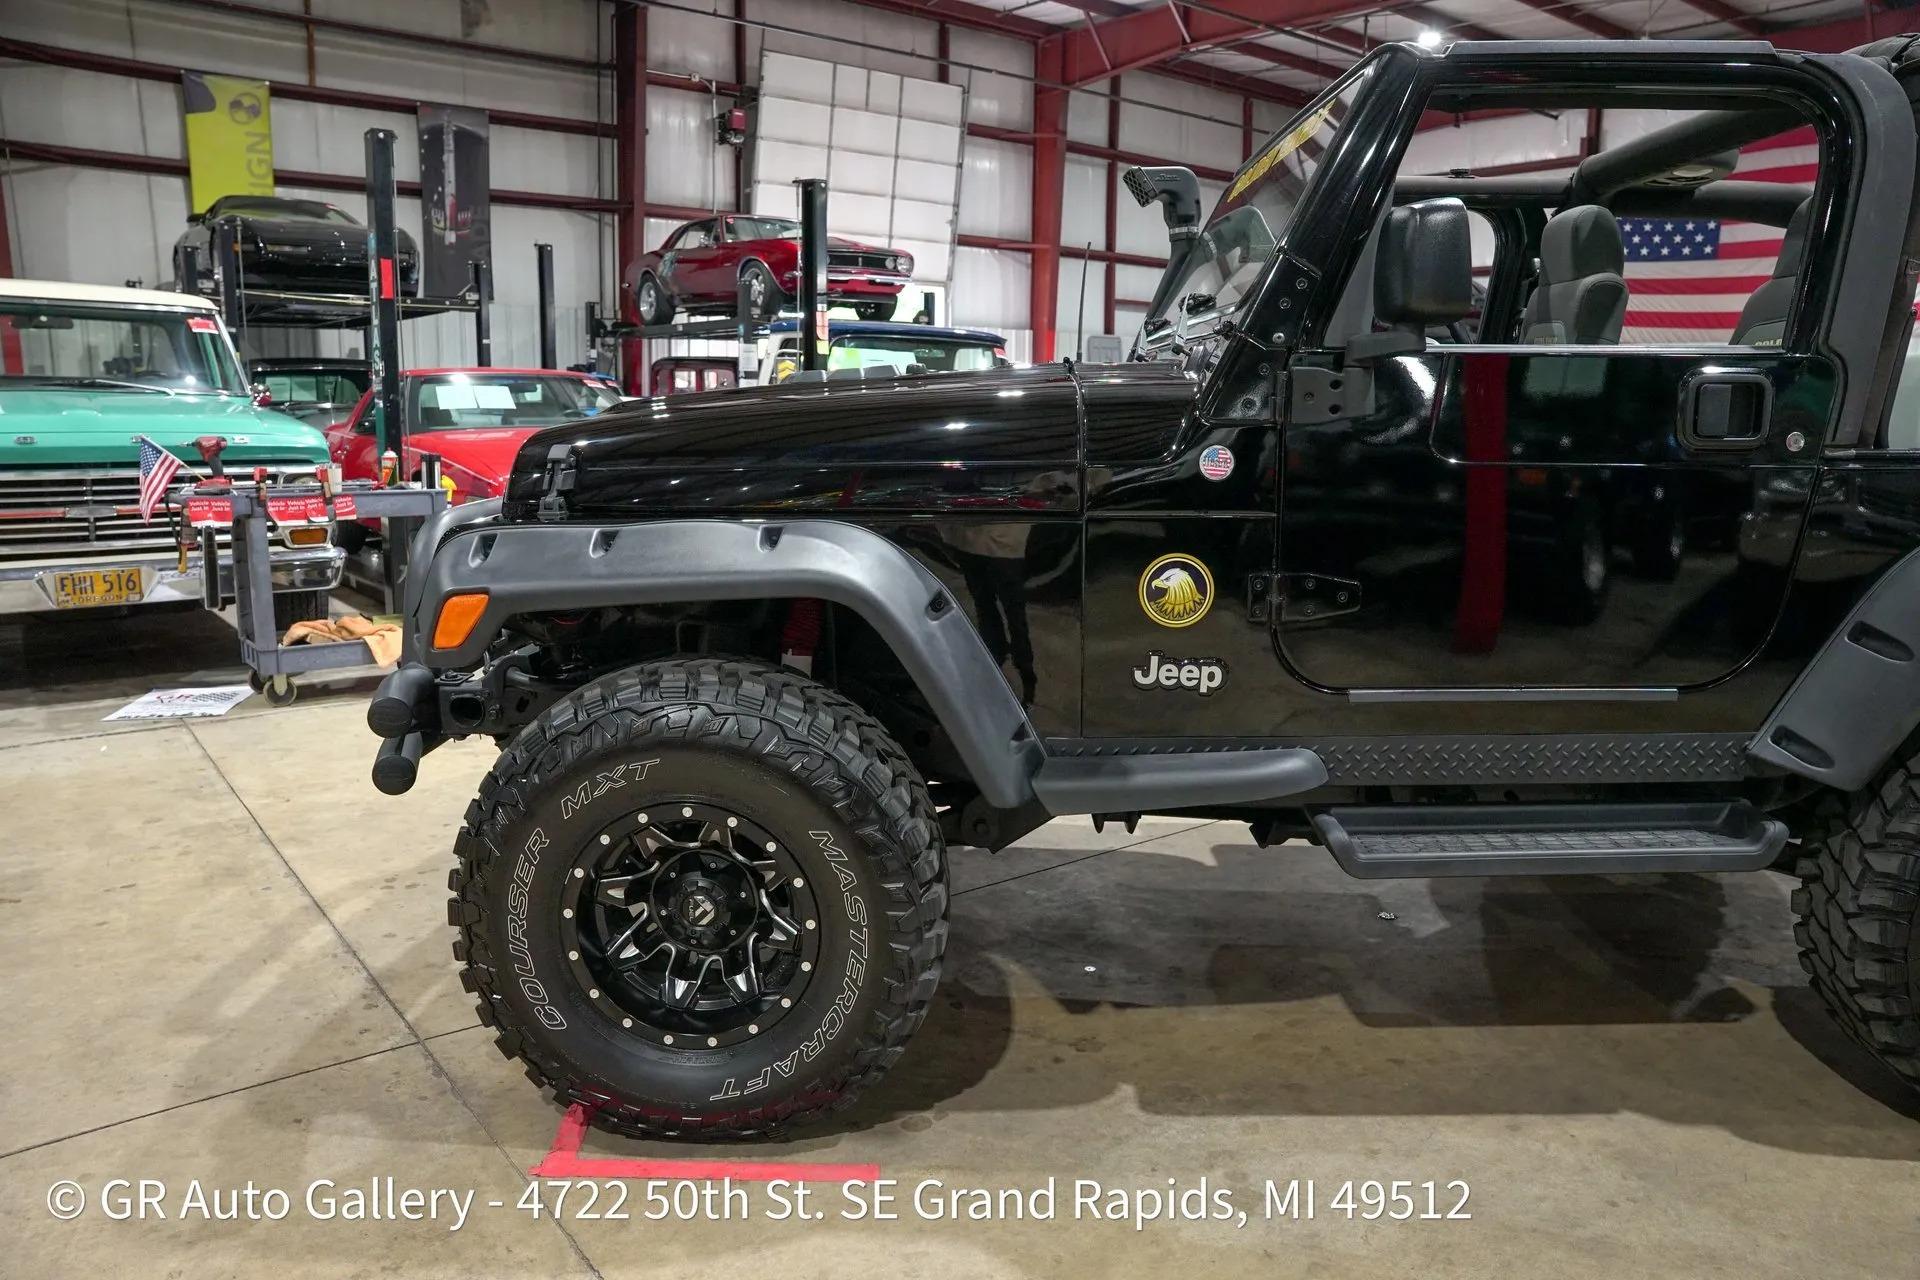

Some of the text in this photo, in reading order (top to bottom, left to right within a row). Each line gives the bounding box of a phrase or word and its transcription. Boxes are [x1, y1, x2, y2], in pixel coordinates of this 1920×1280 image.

[369, 257, 382, 371] ATLAS
[102, 572, 137, 593] 516
[1133, 655, 1223, 693] Jeep
[508, 758, 661, 1030] COURSER MXT
[709, 830, 869, 1101] MASTERCRAFT
